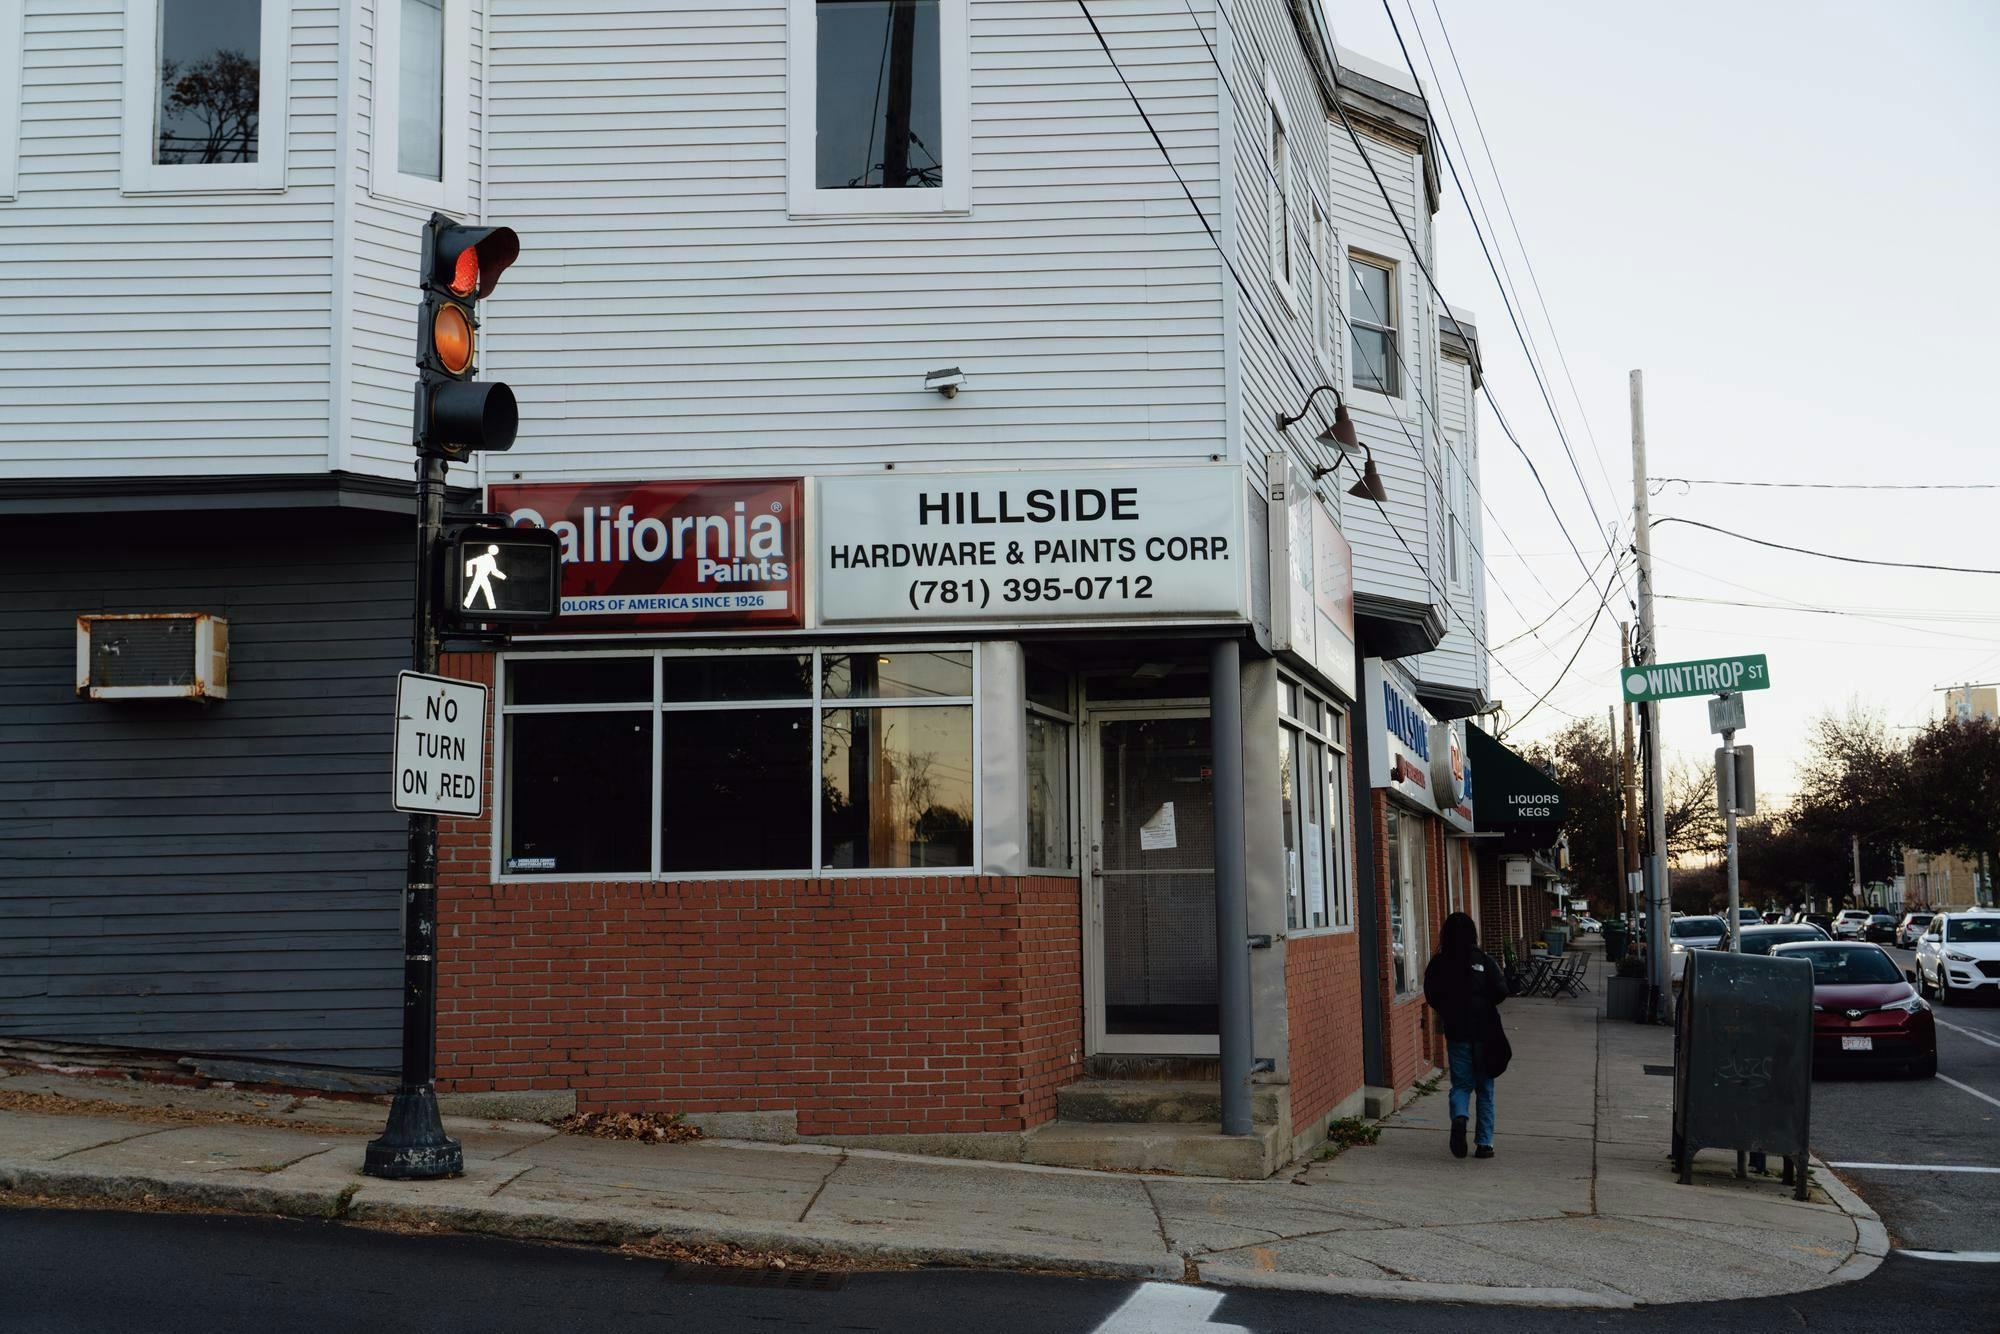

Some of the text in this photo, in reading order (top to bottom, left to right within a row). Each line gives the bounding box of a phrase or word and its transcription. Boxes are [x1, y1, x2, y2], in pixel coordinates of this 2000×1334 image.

[919, 488, 1140, 526] HILLSIDE
[511, 502, 784, 564] alifornia
[830, 536, 1229, 569] HARDWARE & PAINTS CORP.
[697, 558, 788, 583] Paints
[560, 595, 765, 613] OLORS OF AMERICA SINCE 1926
[909, 575, 1153, 611] (781) 395-0712
[1646, 661, 1763, 695] WINTHROP ST
[426, 695, 458, 723] NO
[415, 731, 466, 762] TURN
[402, 768, 476, 800] ON RED
[1508, 794, 1560, 805] LIQUORS
[1518, 807, 1550, 817] KEGS
